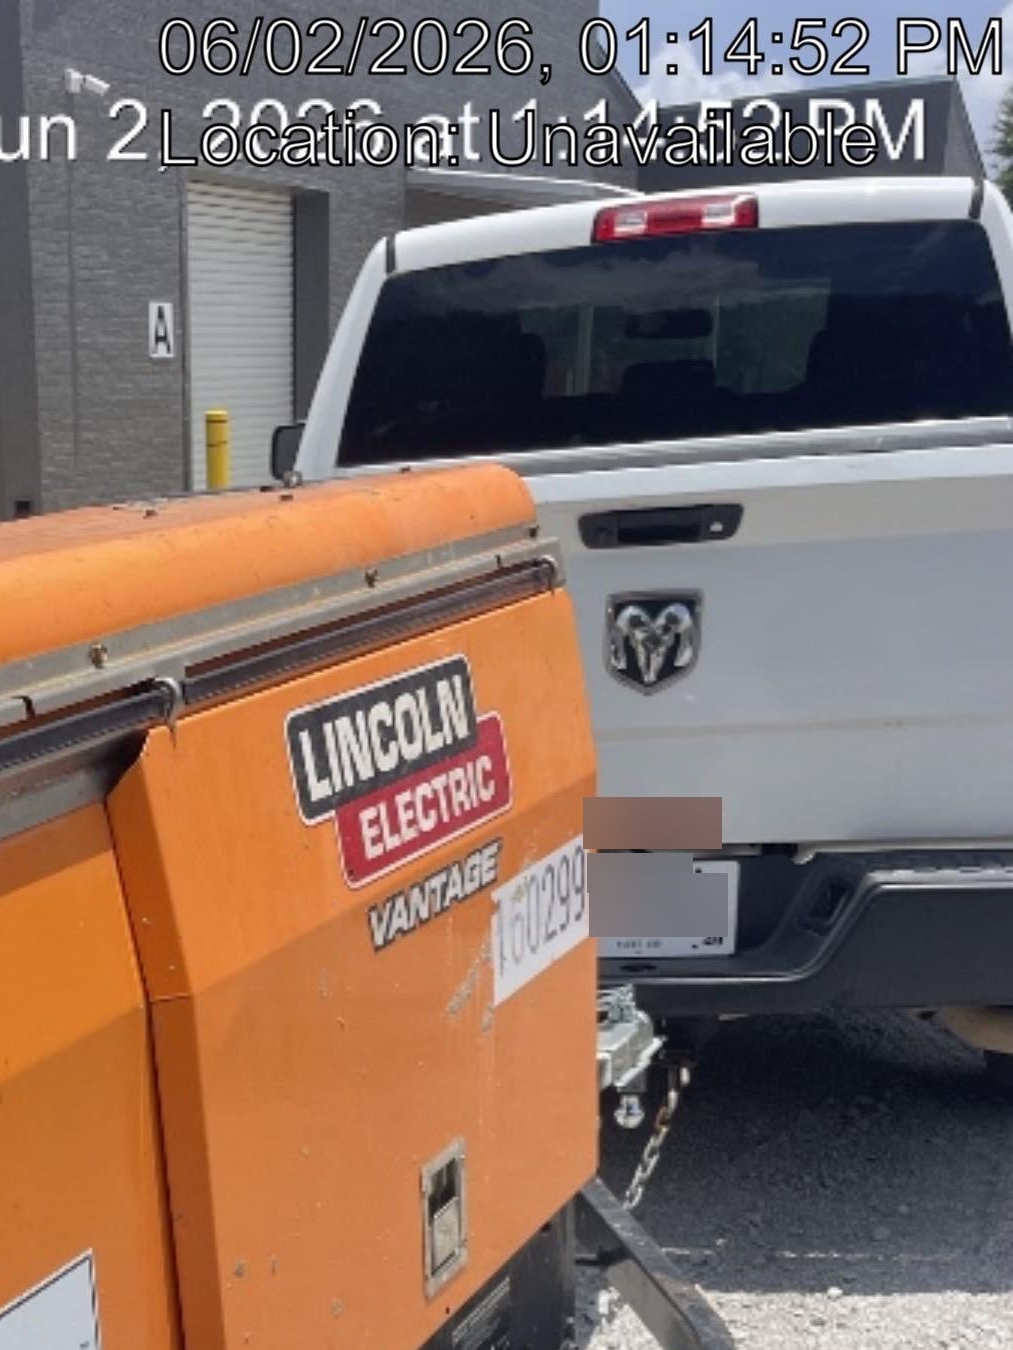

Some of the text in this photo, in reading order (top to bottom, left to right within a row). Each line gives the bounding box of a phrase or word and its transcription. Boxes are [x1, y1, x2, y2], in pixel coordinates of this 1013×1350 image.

[152, 304, 171, 355] A
[299, 673, 471, 802] LINCOLN
[359, 755, 497, 861] ELECTRIC
[368, 837, 503, 953] VANTAGE
